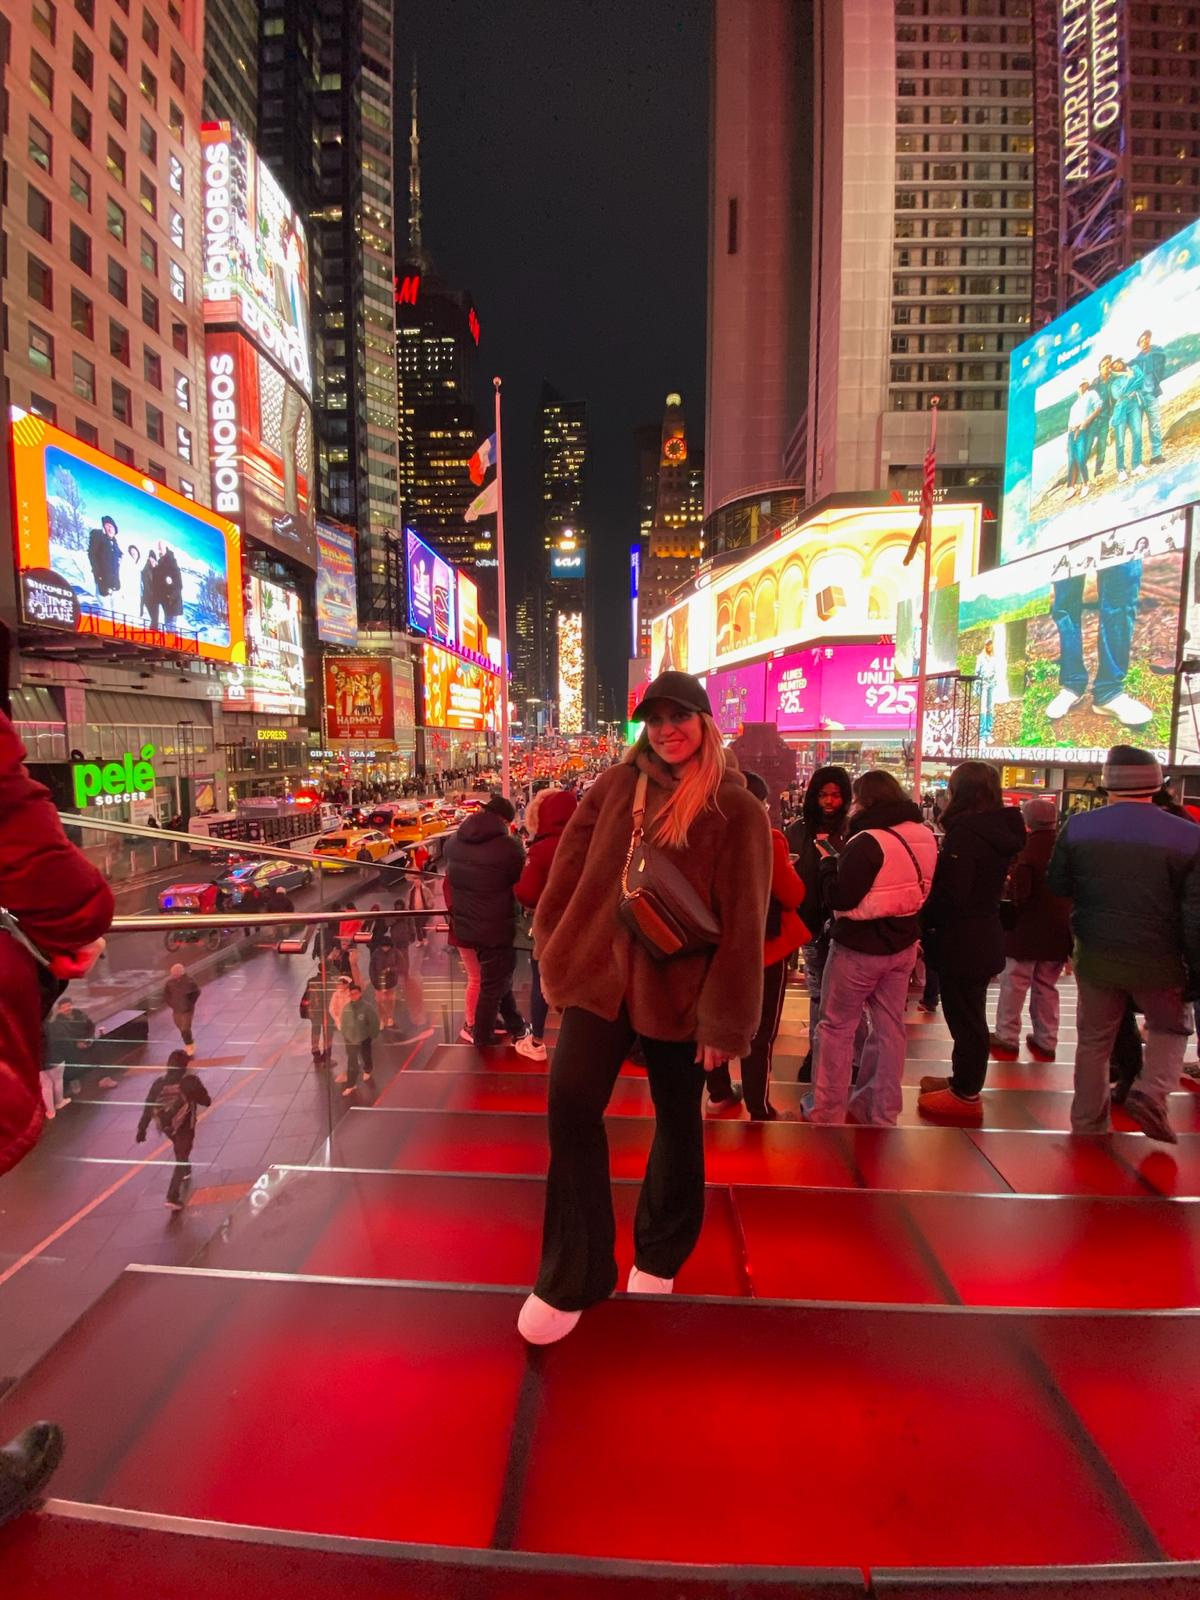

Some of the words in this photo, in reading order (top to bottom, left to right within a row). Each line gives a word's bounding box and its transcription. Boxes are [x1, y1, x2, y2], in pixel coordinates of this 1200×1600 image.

[1062, 14, 1089, 180] AMERICAN
[205, 142, 231, 302] BONOBOS
[210, 353, 240, 513] BONOBOS
[870, 657, 880, 671] 4
[864, 684, 917, 715] $25
[257, 729, 288, 740] EXPRESS
[336, 715, 384, 725] HARMONY
[73, 743, 156, 809] pelé
[95, 792, 146, 806] SOCCER
